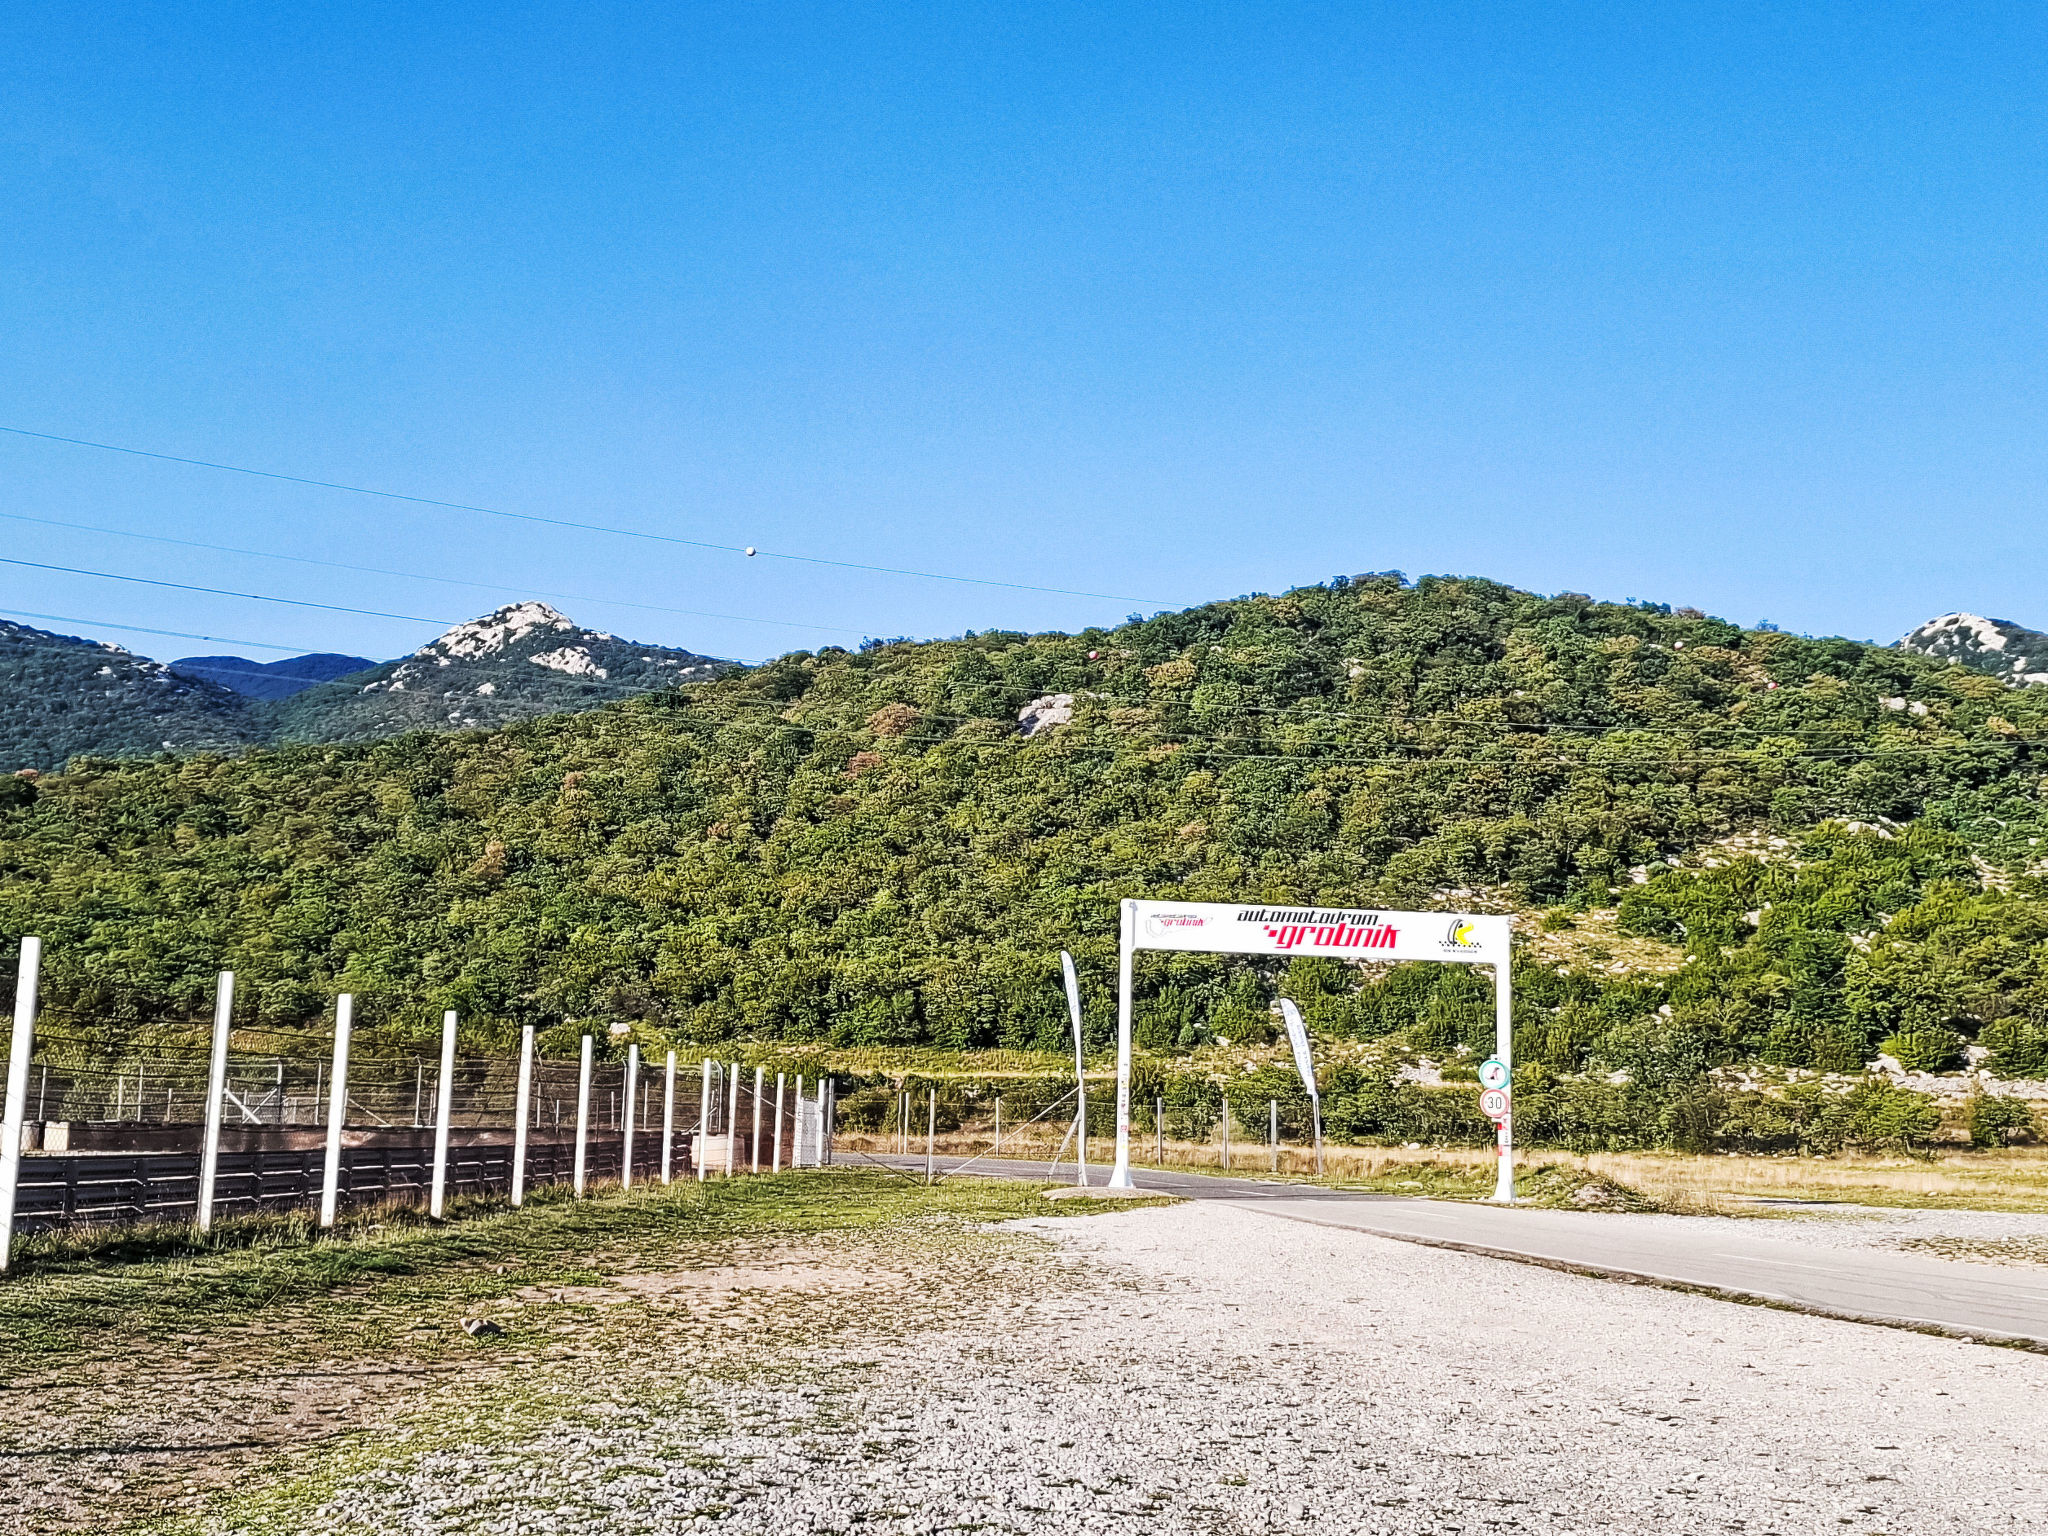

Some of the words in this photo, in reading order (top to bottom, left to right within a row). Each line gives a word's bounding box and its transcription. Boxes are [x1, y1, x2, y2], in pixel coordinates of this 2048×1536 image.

[1237, 909, 1378, 926] automotodrom
[1274, 923, 1401, 949] grobnik
[1487, 1096, 1502, 1109] 30
